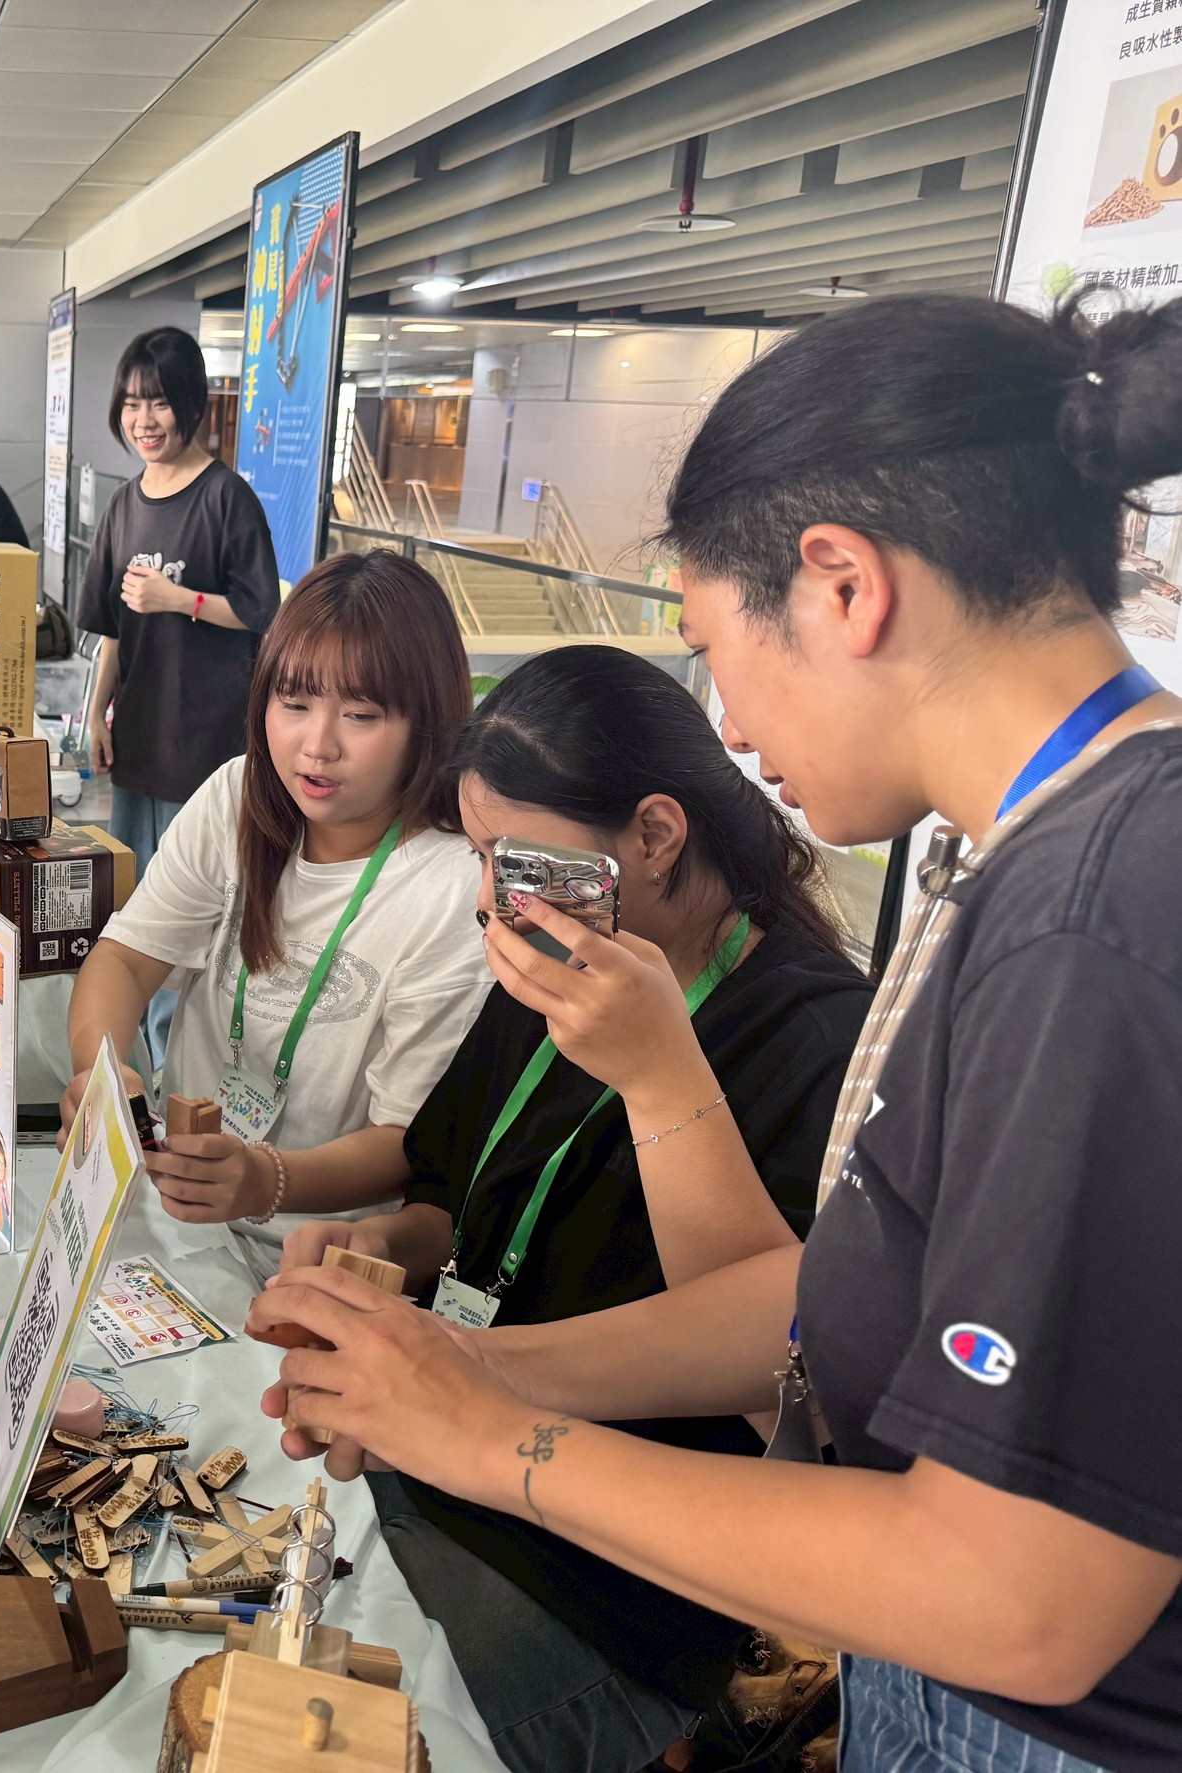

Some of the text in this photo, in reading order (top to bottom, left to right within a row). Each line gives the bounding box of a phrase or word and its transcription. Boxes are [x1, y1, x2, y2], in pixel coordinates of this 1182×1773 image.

[13, 871, 21, 911] PELLETS
[220, 1451, 246, 1476] WOOD
[100, 1492, 131, 1521] WOOD
[79, 1528, 99, 1566] WOOD
